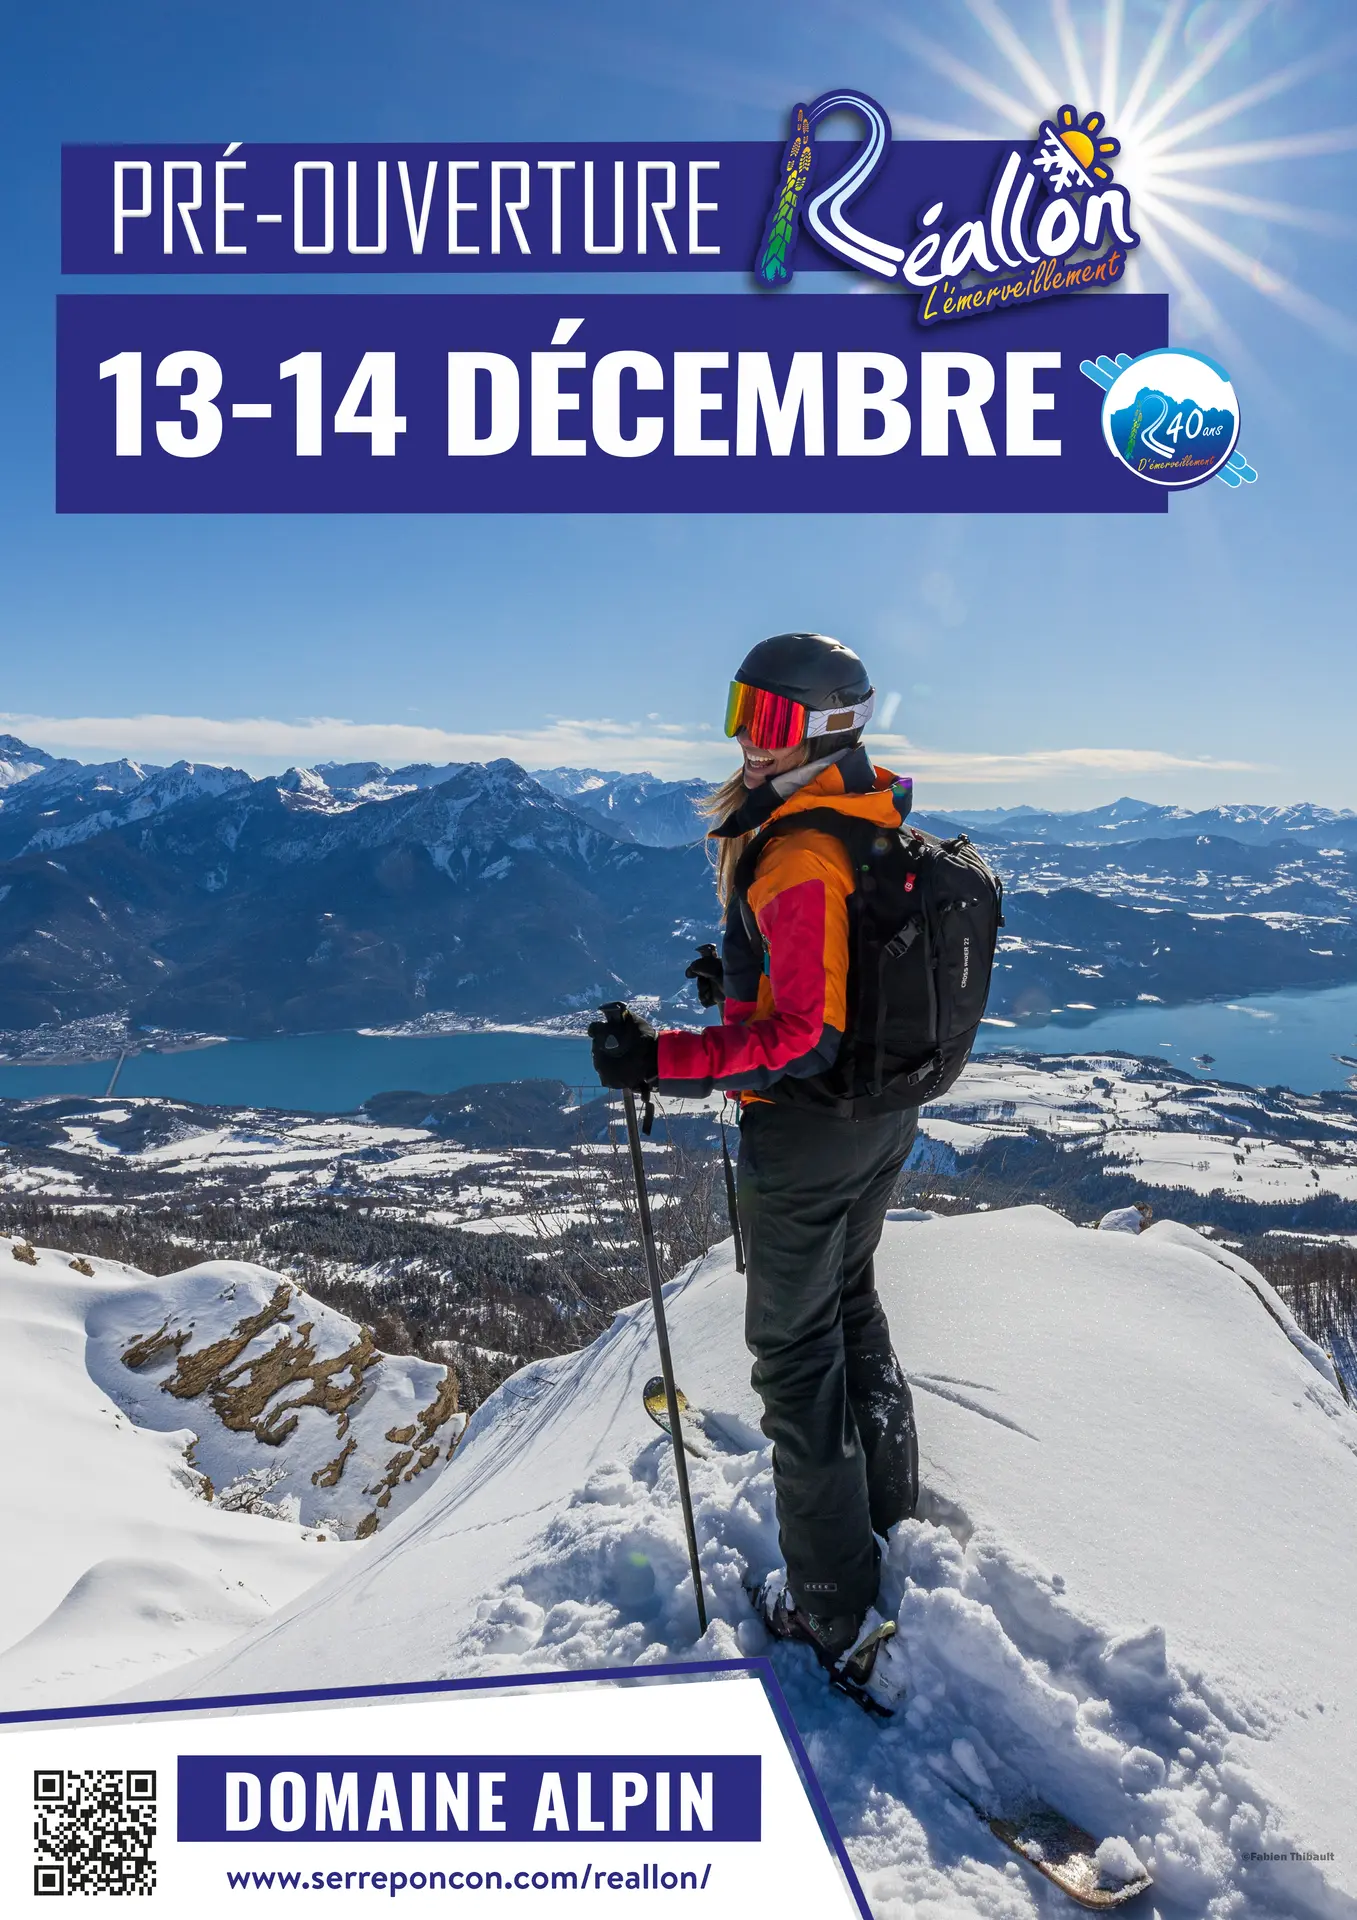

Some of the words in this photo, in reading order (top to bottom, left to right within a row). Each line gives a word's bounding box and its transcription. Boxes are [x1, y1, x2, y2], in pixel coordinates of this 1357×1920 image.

[114, 142, 720, 255] PRÉ-OUVERTURE
[761, 95, 1134, 286] Réallon
[923, 250, 1121, 320] L'émerveillement
[99, 350, 407, 458] 13-14
[447, 318, 1062, 458] DÉCEMBRE
[1166, 408, 1203, 443] 40
[1202, 425, 1223, 437] ans
[963, 937, 970, 946] 22
[961, 967, 969, 988] CROSS
[225, 1771, 507, 1832] DOMAINE
[533, 1771, 713, 1832] ALPIN
[226, 1863, 712, 1898] www.serreponcon.com/reallon/
